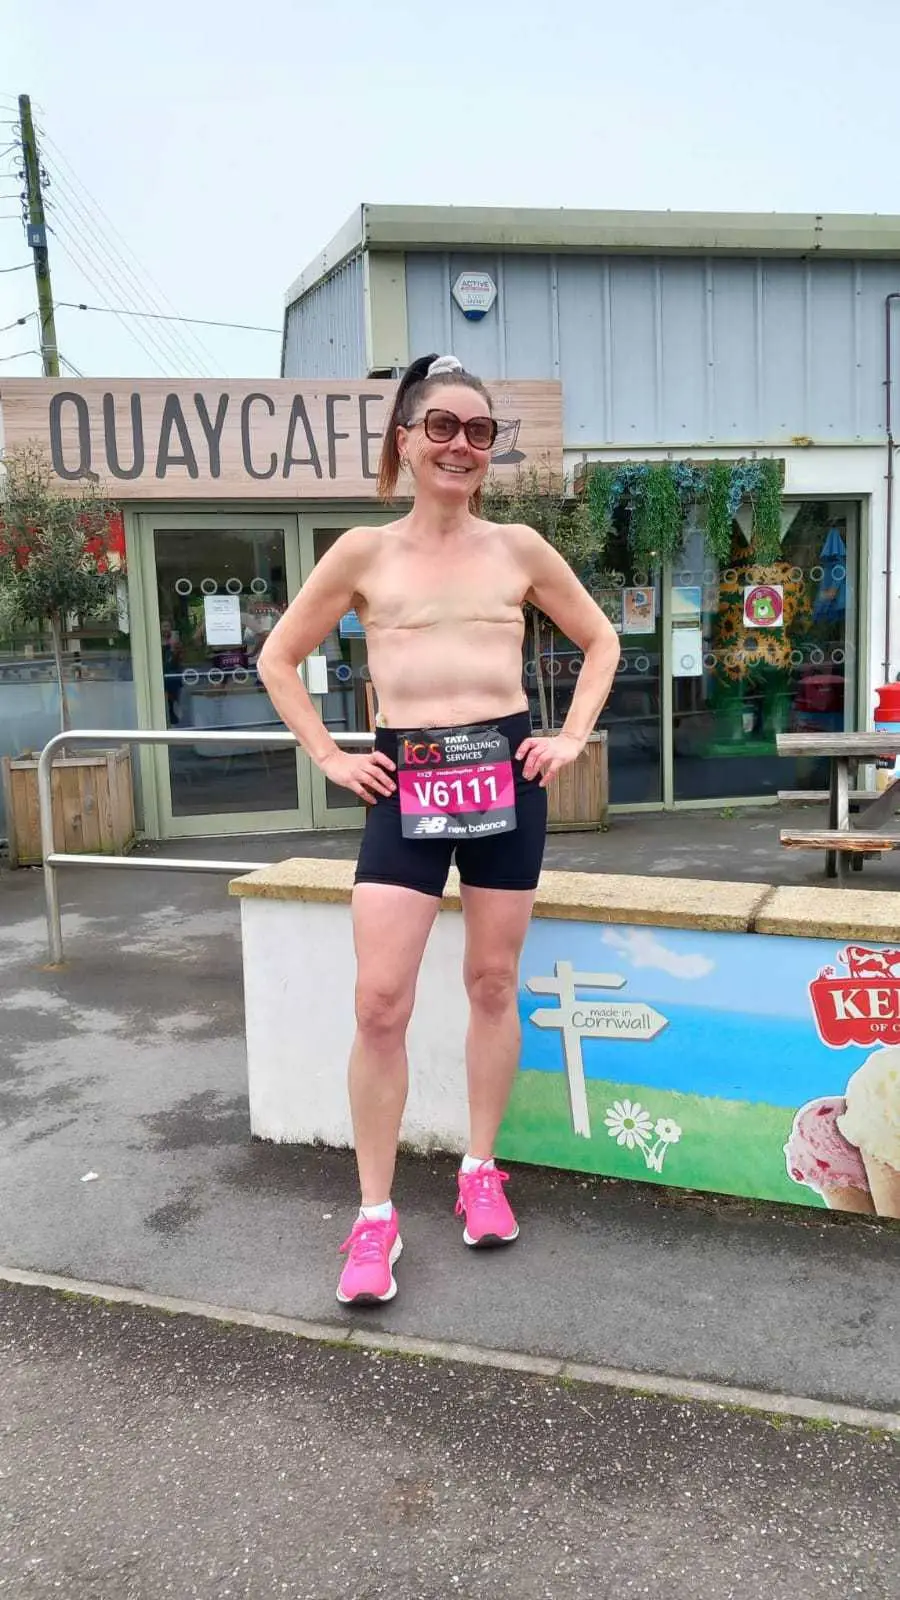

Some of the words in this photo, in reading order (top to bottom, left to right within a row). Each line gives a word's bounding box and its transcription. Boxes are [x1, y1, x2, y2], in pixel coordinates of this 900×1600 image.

[444, 735, 469, 744] TATA
[404, 739, 442, 764] tcs
[445, 740, 500, 753] CONSULTANCY
[446, 751, 482, 762] SERVICES
[413, 776, 497, 807] V6111
[448, 826, 468, 834] new
[468, 820, 507, 832] balance
[828, 988, 900, 1020] KE
[590, 1008, 619, 1017] made
[622, 1008, 632, 1017] in
[572, 1011, 650, 1029] Cornwall
[870, 1023, 888, 1032] OF
